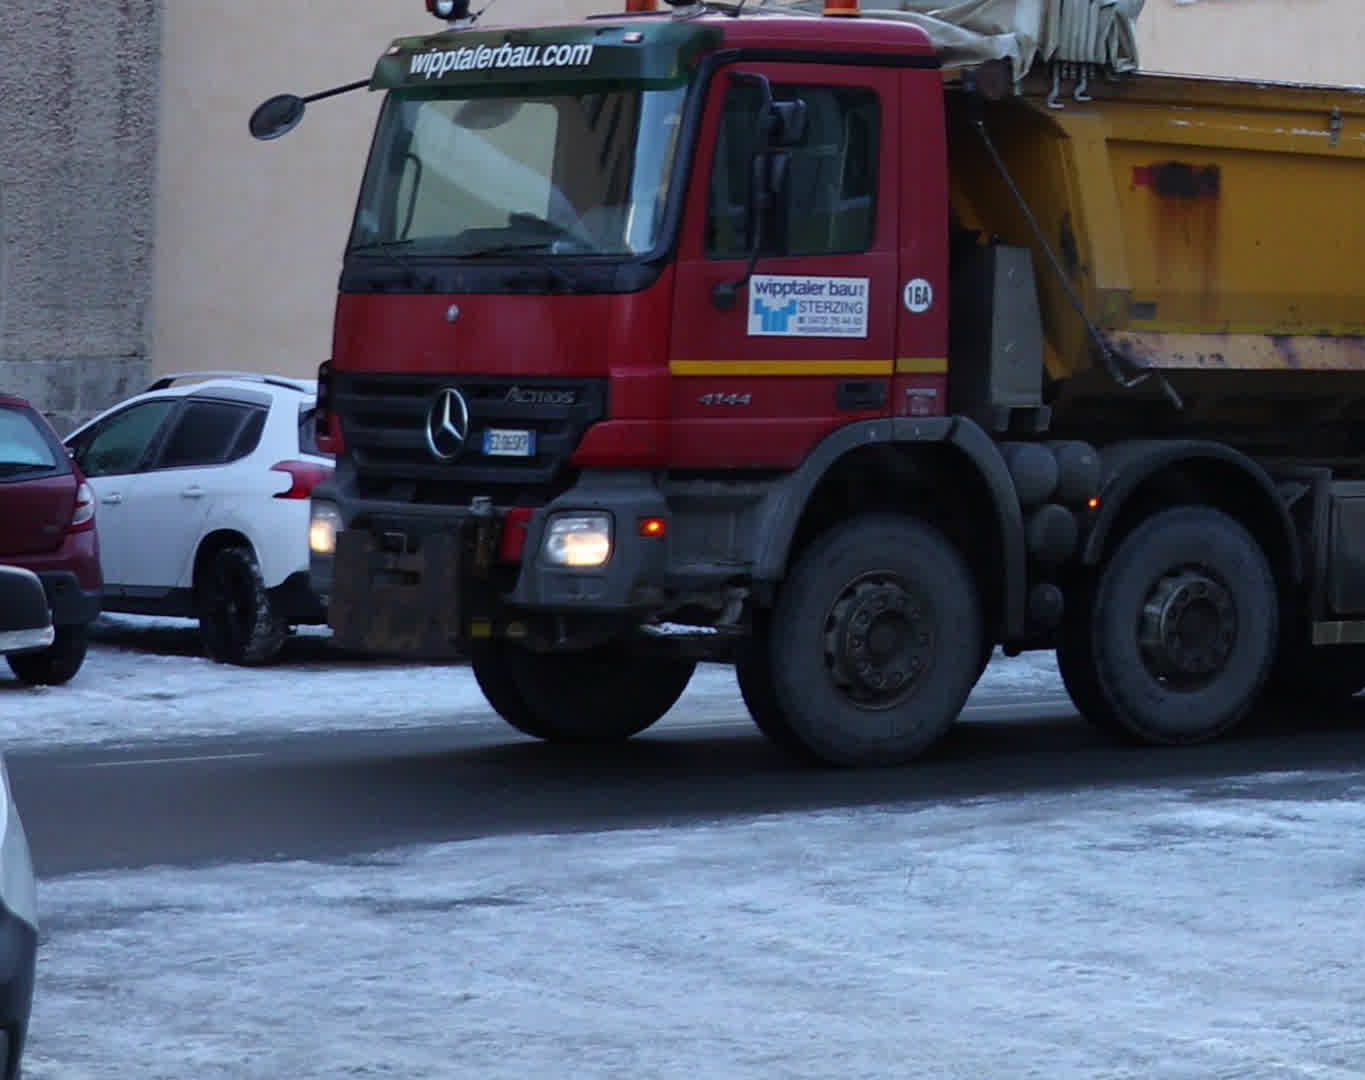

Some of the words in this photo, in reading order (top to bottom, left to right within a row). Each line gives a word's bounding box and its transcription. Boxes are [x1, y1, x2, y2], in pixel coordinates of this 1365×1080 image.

[409, 42, 593, 80] wipptalerbau.com
[754, 279, 825, 298] wipptaler
[828, 280, 858, 296] bau
[799, 300, 864, 314] STERZING
